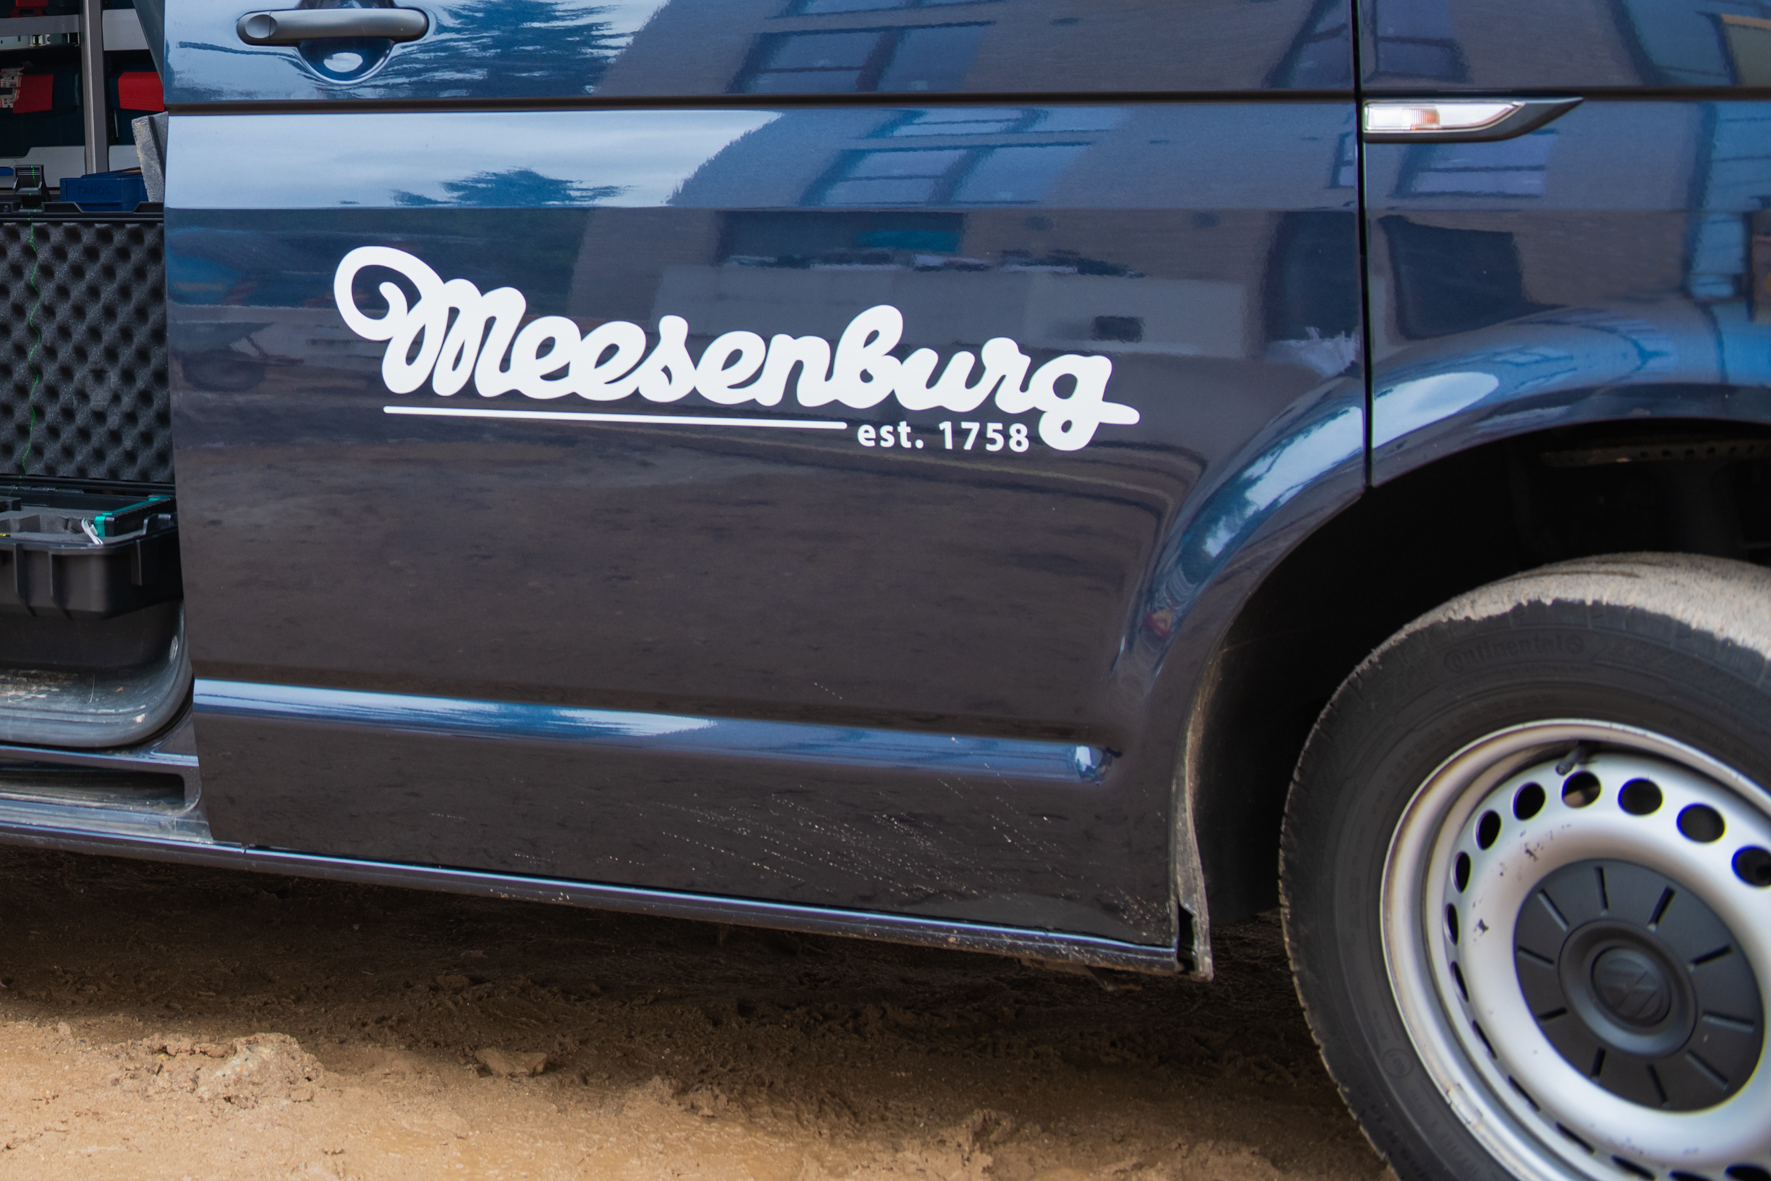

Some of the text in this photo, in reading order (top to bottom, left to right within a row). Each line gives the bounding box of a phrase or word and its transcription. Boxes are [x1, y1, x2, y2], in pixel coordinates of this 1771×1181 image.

[76, 185, 112, 196] TANOS
[333, 246, 1140, 451] Meesenburg
[857, 421, 1030, 453] est. 1758
